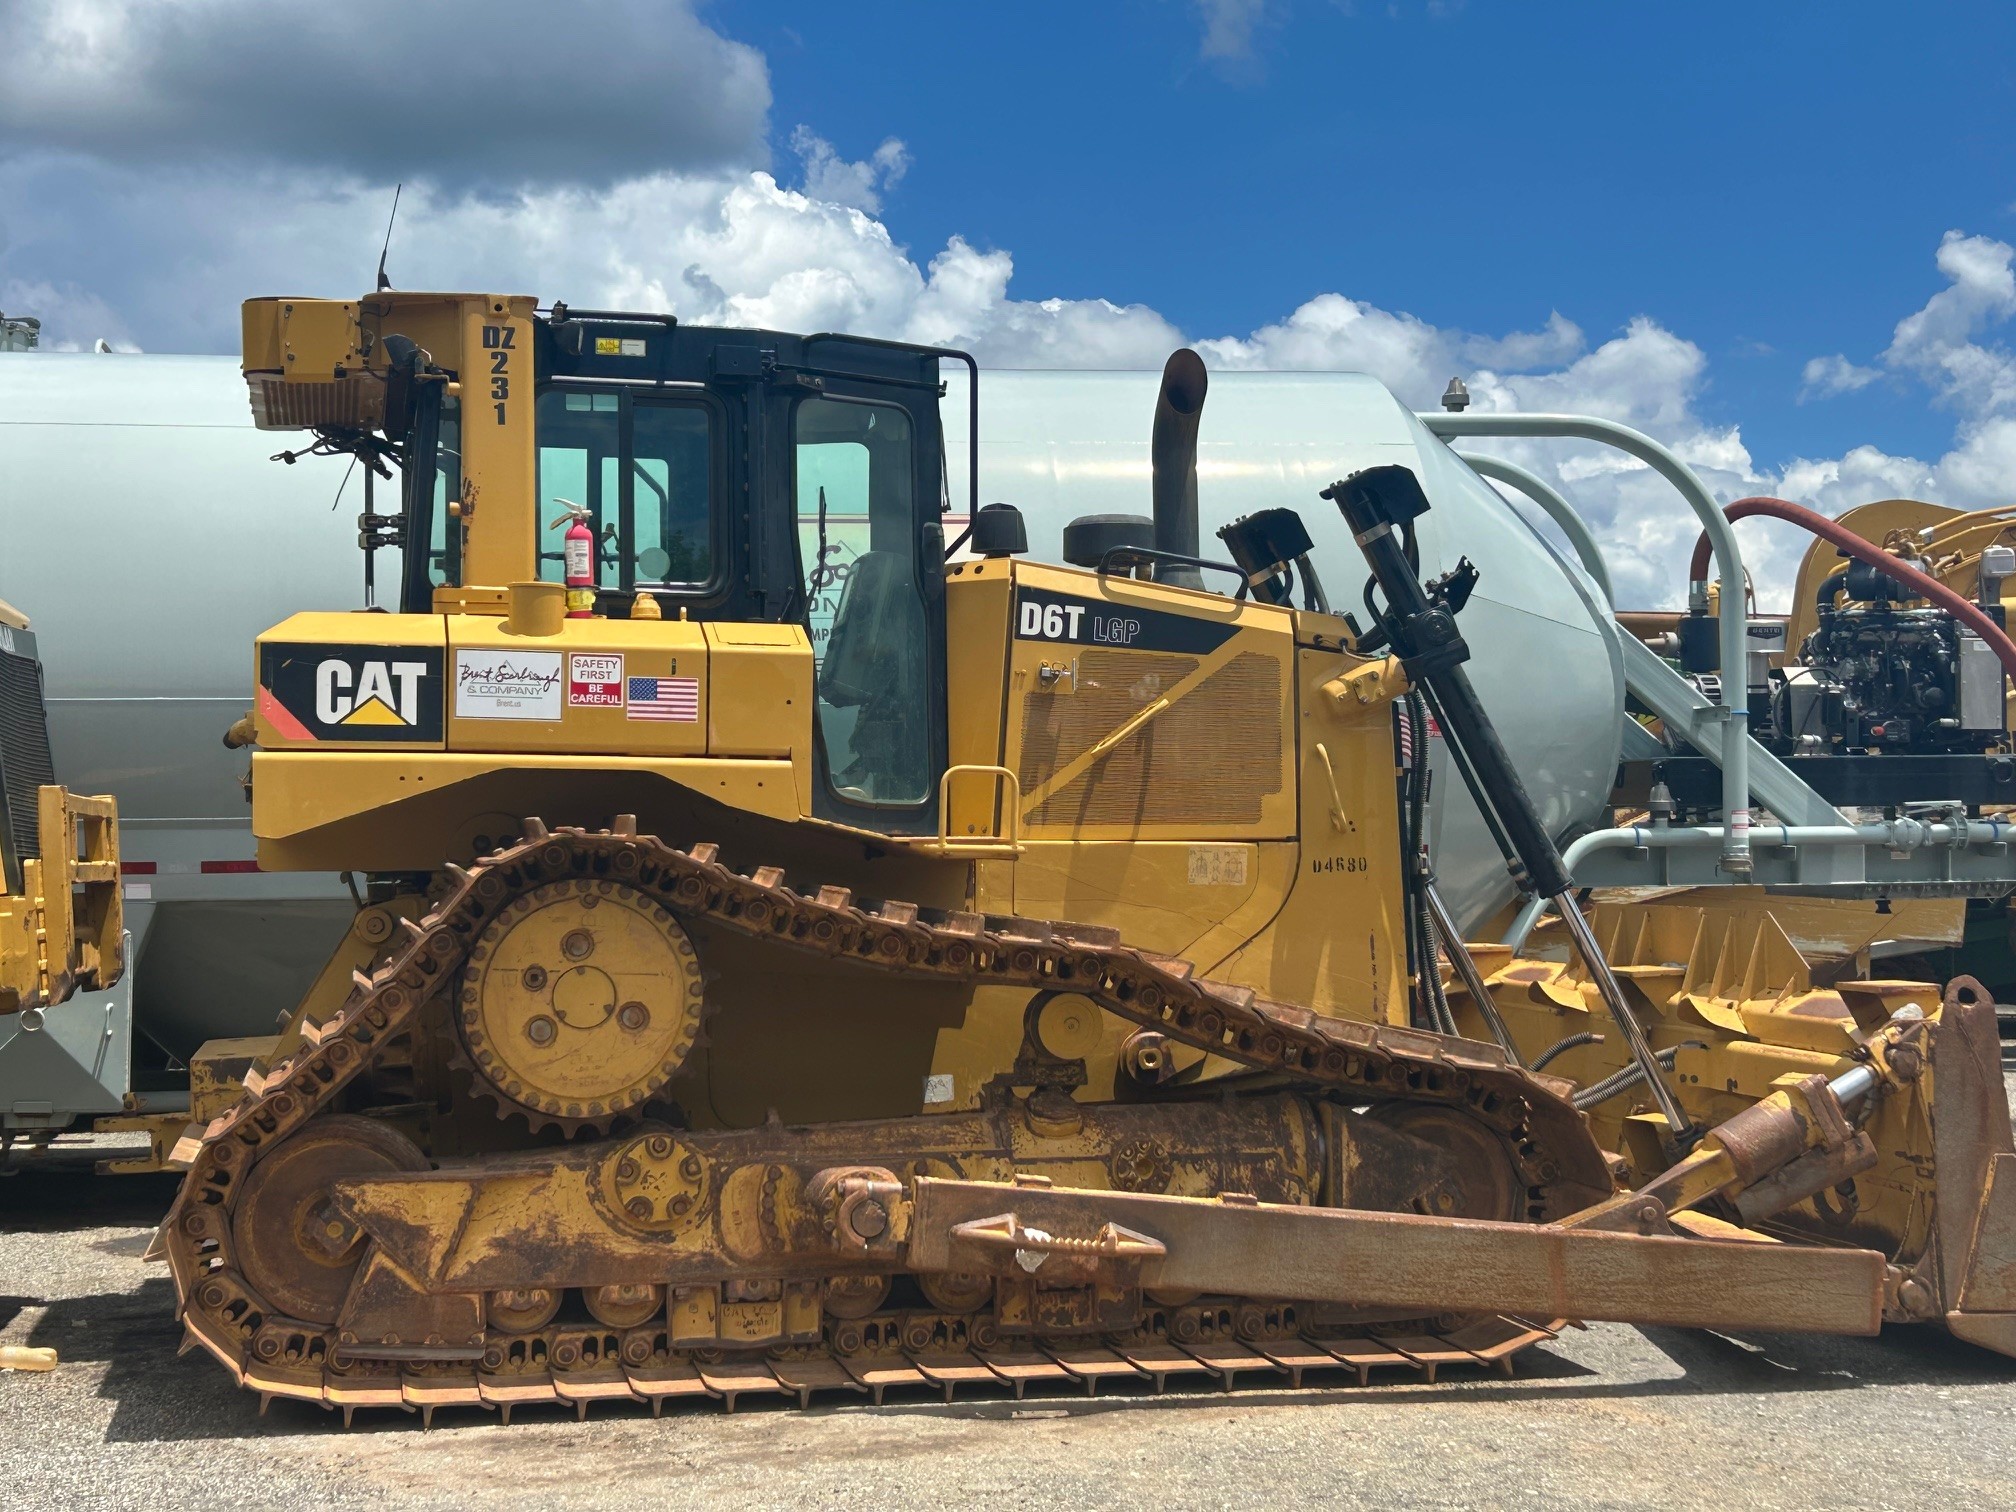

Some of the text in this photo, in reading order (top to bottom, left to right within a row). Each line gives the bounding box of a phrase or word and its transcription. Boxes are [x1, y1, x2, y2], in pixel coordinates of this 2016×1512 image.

[1020, 601, 1140, 644] D6T LGP
[573, 658, 618, 670] SAFETY
[579, 670, 613, 680] FIRST
[316, 658, 427, 726] CAT
[466, 685, 543, 696] & COMPANY
[588, 683, 604, 693] BE
[570, 693, 622, 705] CAREFUL
